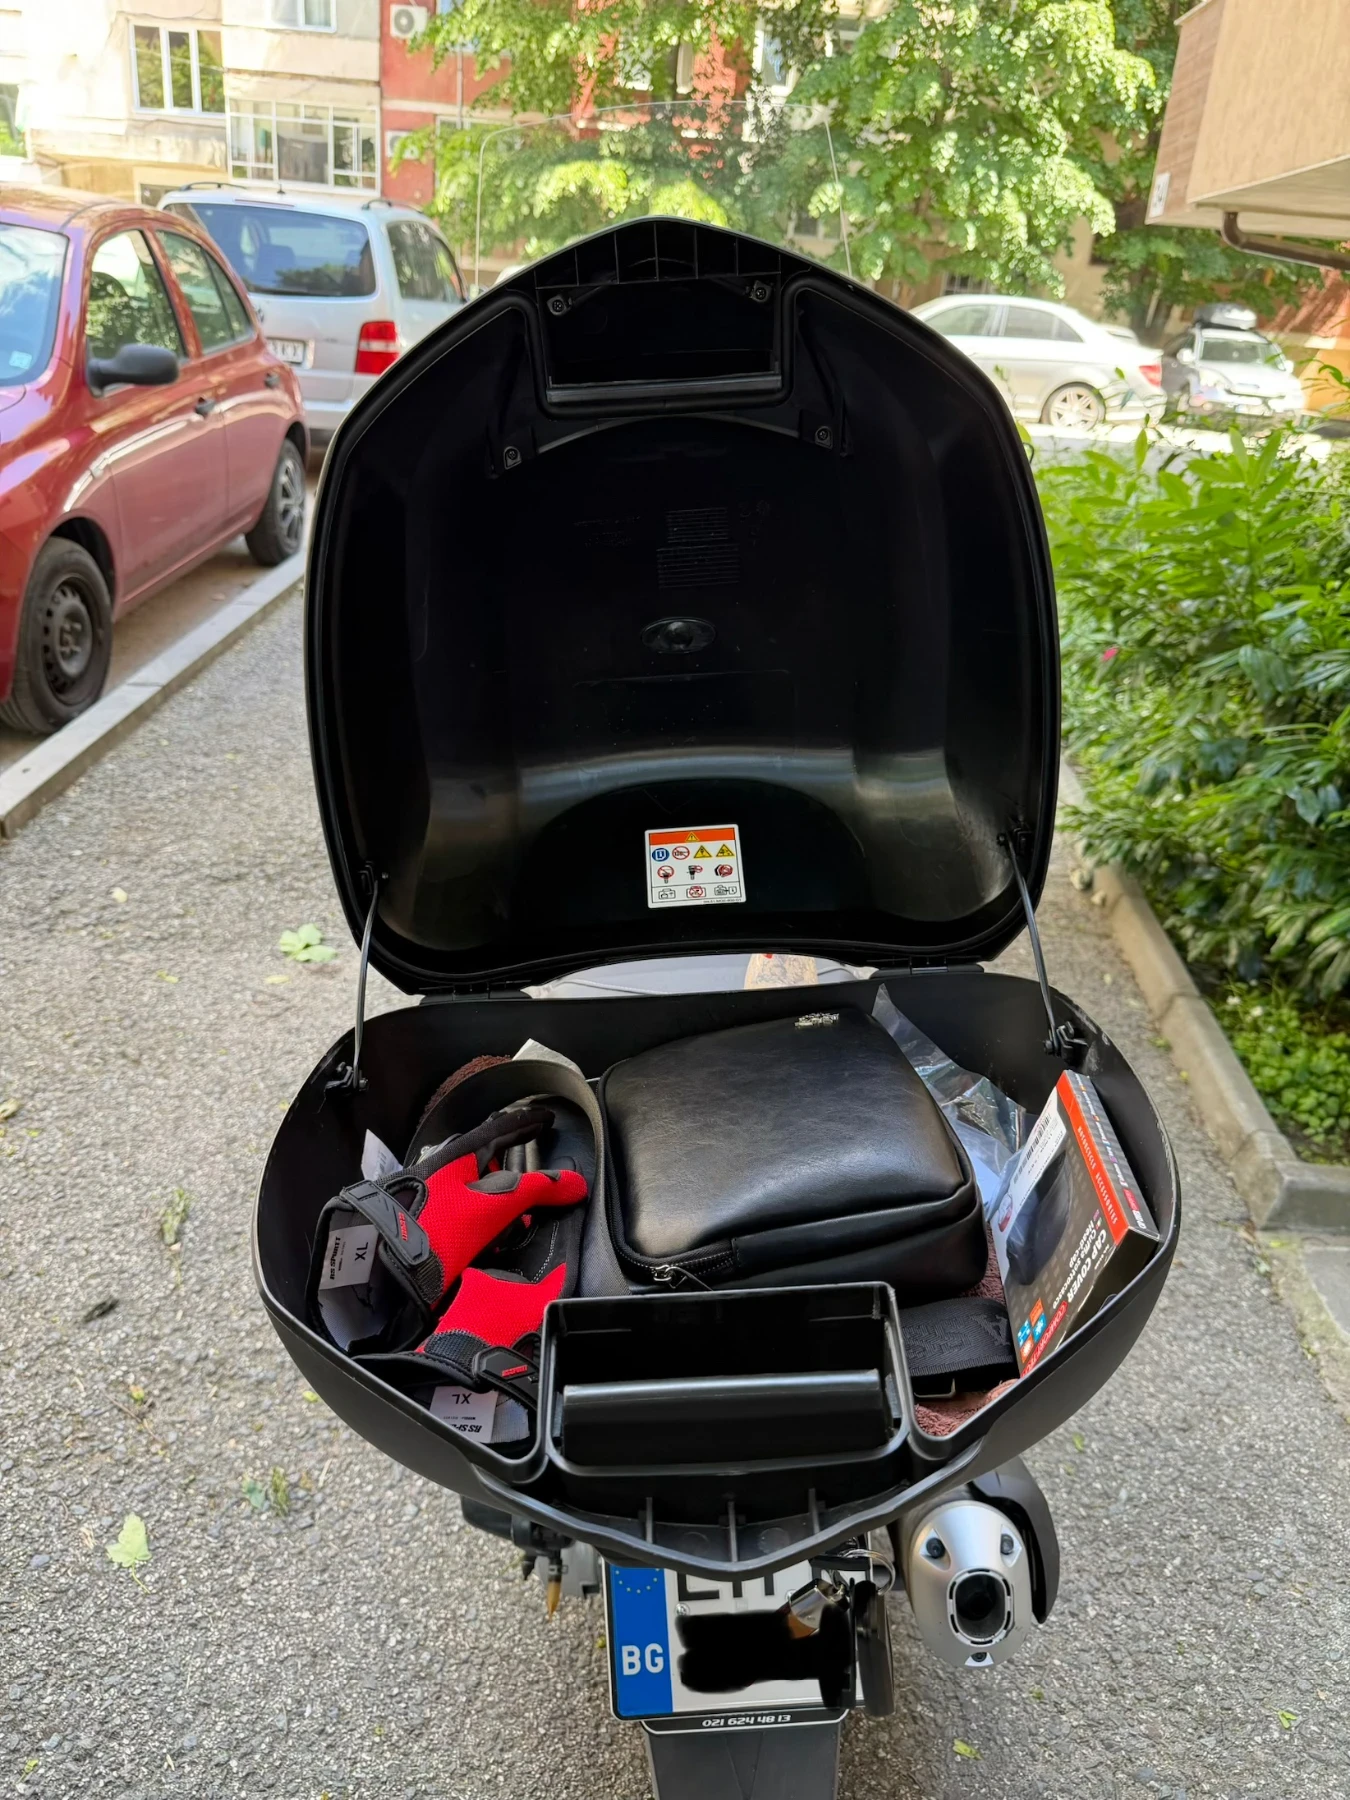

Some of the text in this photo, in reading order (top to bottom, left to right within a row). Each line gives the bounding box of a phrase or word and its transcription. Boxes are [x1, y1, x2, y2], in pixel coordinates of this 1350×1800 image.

[1077, 1125, 1097, 1170] MOTORCYCLE
[1095, 1171, 1118, 1225] ACCESSORIES
[354, 1241, 369, 1261] XL
[1091, 1229, 1107, 1260] CAP
[1052, 1257, 1082, 1309] sottocasco
[1067, 1257, 1092, 1303] COVER
[451, 1392, 472, 1405] XL
[621, 1643, 664, 1676] BG
[702, 1714, 792, 1727] 021 624 48 13
